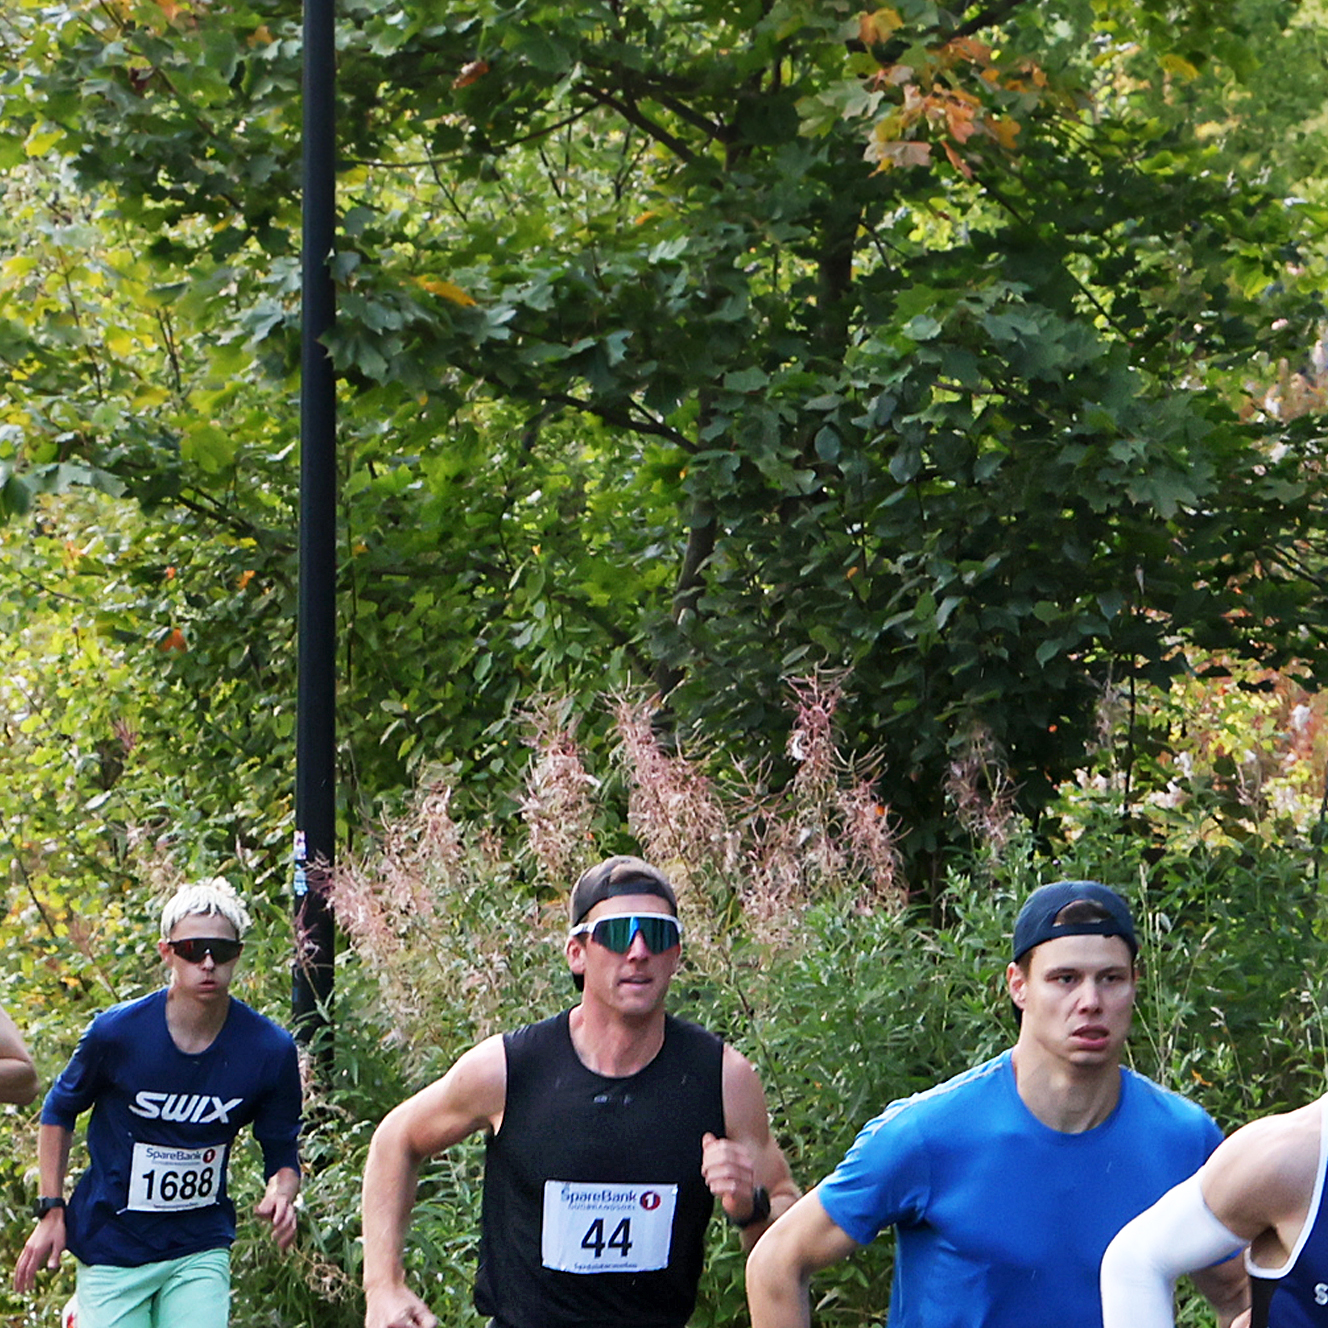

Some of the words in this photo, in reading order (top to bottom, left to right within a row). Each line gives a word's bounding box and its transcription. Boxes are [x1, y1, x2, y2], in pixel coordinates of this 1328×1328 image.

[129, 1091, 243, 1123] SWIX
[146, 1148, 202, 1160] SpareBank
[142, 1167, 214, 1201] 1688
[561, 1187, 637, 1204] SpareBank
[581, 1217, 633, 1259] 44
